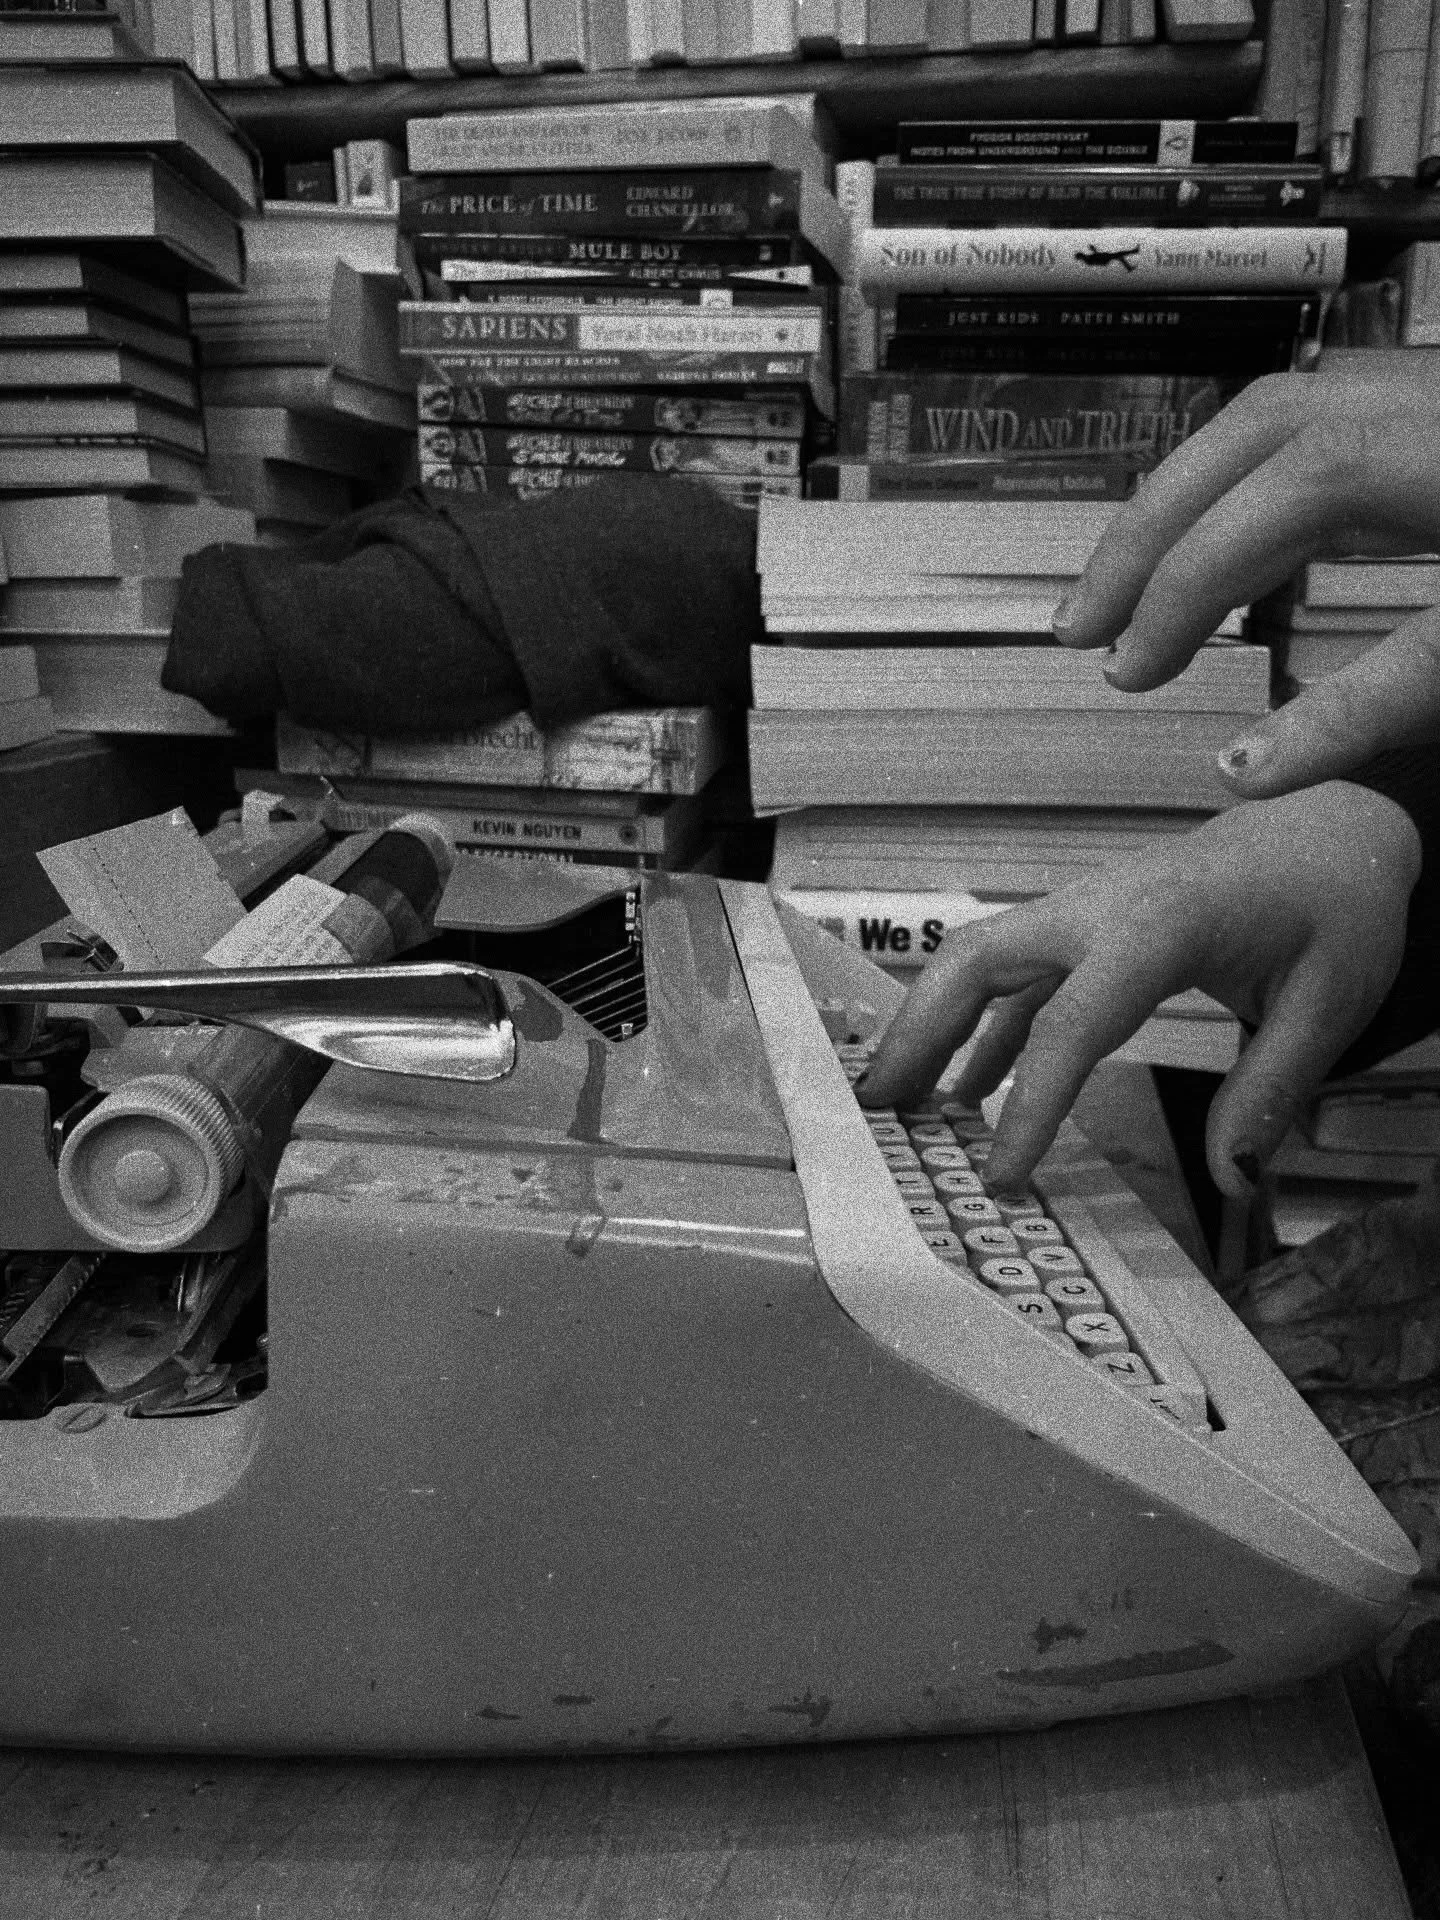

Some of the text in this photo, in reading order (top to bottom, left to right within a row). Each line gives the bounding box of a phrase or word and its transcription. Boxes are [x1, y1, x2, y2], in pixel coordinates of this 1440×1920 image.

[421, 199, 445, 214] The
[449, 194, 516, 214] PRICE
[539, 193, 598, 213] TIME
[569, 243, 632, 260] MULE
[640, 244, 683, 261] BOY
[881, 244, 1055, 270] Son of Nobody
[948, 311, 1181, 327] JUST KIDS PATTI SMITH
[441, 315, 568, 340] SAPIENS
[926, 408, 1019, 453] WIND
[1022, 417, 1074, 449] AND
[1077, 409, 1191, 456] TRUTH
[472, 820, 582, 840] KEVIN NGUYEN
[860, 918, 911, 952] We
[874, 1126, 896, 1135] U
[935, 1151, 956, 1160] J
[896, 1178, 918, 1186] T
[948, 1176, 969, 1186] H
[910, 1205, 934, 1216] R
[964, 1202, 985, 1212] G
[1025, 1224, 1048, 1232] B
[931, 1238, 950, 1248] E
[980, 1234, 1005, 1245] F
[1042, 1252, 1065, 1263] V
[998, 1265, 1023, 1276] D
[1061, 1284, 1087, 1296] C
[1017, 1302, 1044, 1314] S
[1083, 1321, 1110, 1333] X
[1106, 1362, 1135, 1374] Z
